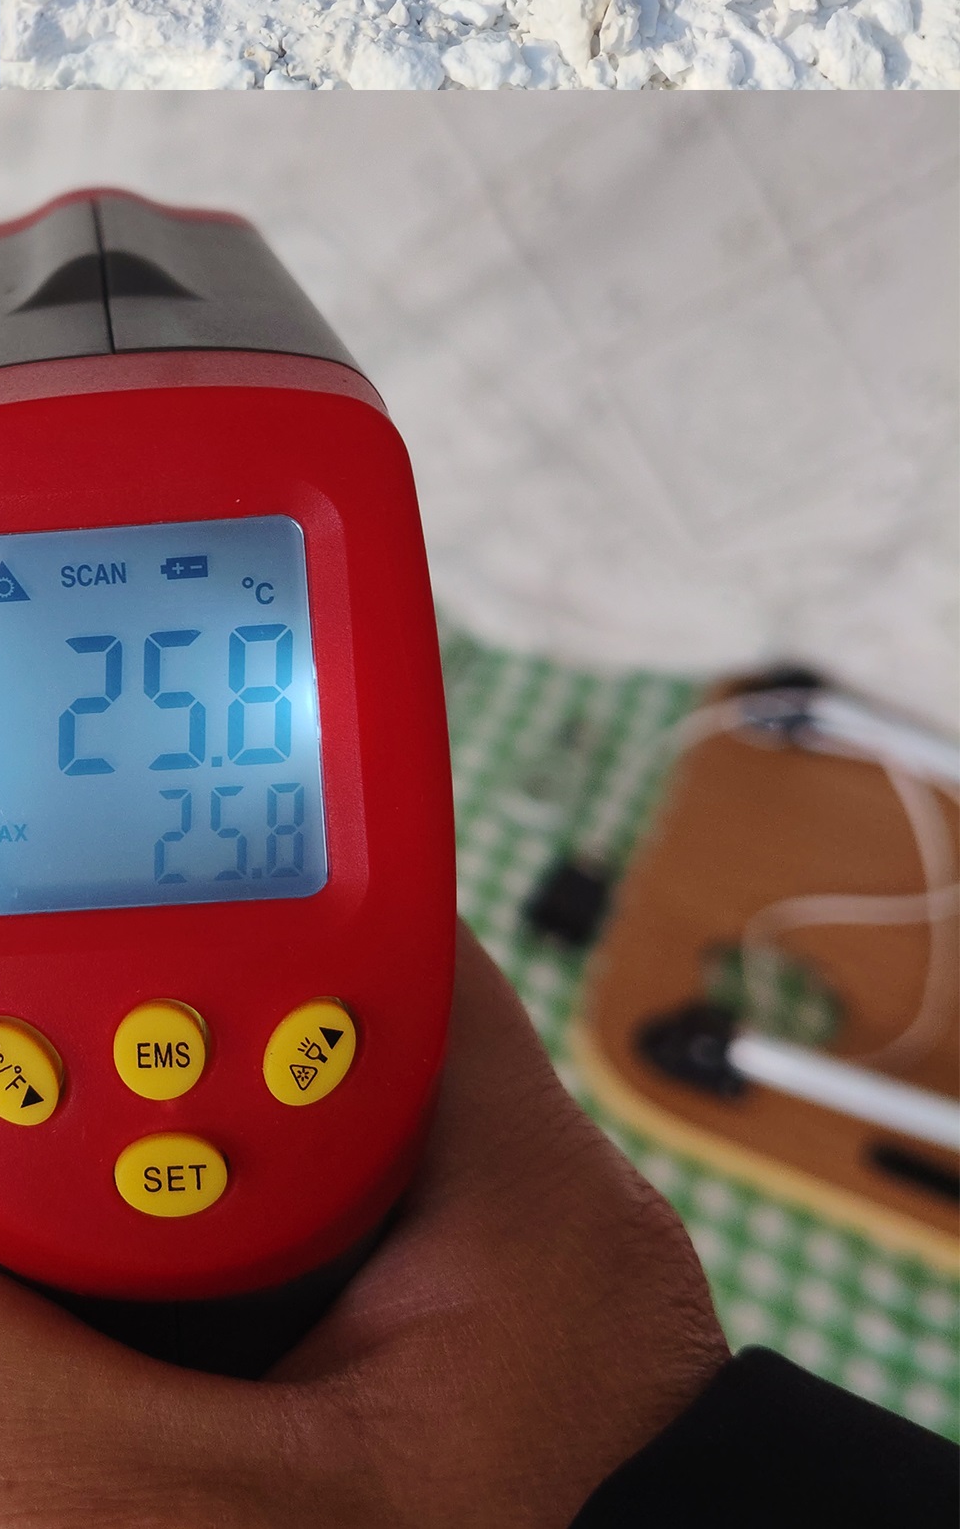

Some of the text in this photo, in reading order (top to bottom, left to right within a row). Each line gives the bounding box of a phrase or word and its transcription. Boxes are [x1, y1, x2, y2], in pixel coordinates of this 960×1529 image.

[60, 562, 128, 589] SCAN
[58, 623, 294, 776] 25.8
[154, 782, 306, 885] 25.8
[136, 1041, 191, 1070] EMS
[142, 1164, 207, 1192] SET
